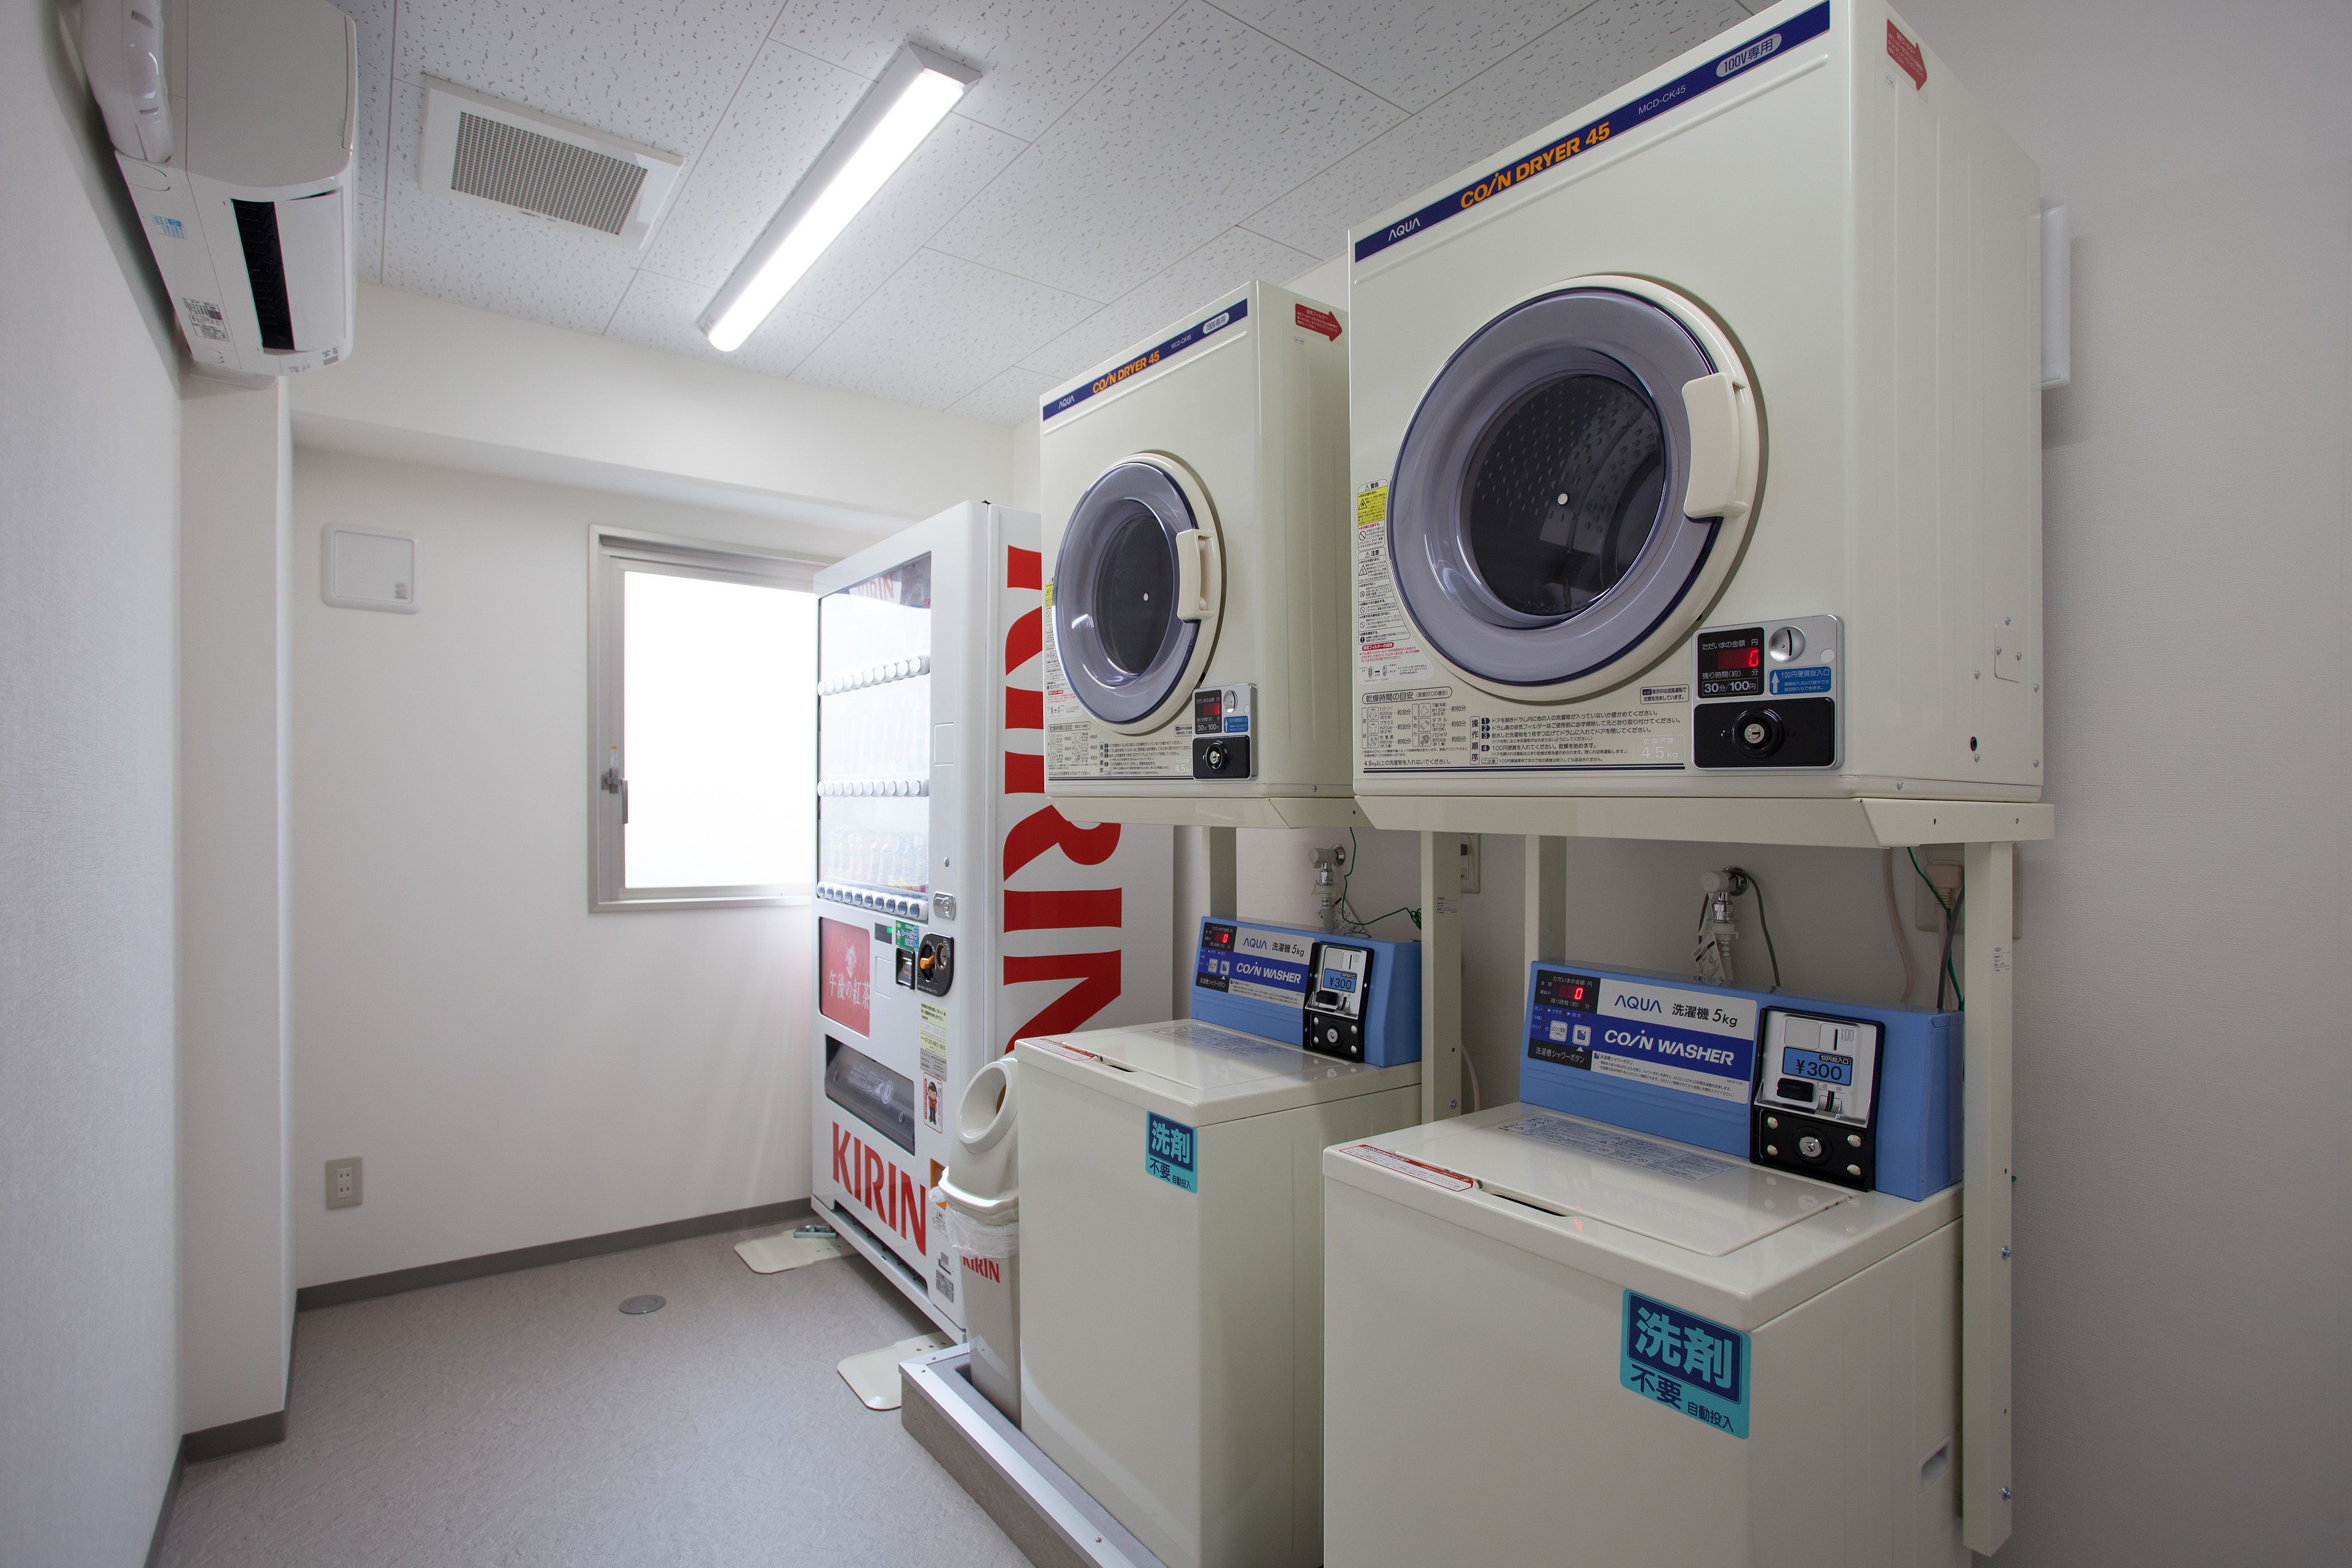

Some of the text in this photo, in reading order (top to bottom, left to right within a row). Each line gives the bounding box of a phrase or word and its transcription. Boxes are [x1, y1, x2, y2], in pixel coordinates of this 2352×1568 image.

[1388, 217, 1421, 242] AQUA
[1515, 138, 1580, 184] DRYER
[1585, 121, 1610, 146] 45
[1638, 85, 1686, 115] MCD-CK45
[1722, 38, 1774, 74] 100V専用
[1058, 394, 1074, 409] AQUA
[1117, 356, 1147, 382] DRYER
[1148, 350, 1159, 364] 45
[1205, 314, 1226, 332] 100V専用
[1702, 639, 1745, 650] ただいまの金額
[1749, 650, 1759, 667] 0
[1781, 669, 1830, 679] 100円硬貨投入口
[1704, 680, 1756, 693] 30分/100円
[1366, 692, 1414, 703] 乾燥時間の目安
[1642, 747, 1678, 760] 4.5 kg
[1222, 933, 1229, 943] 0
[1243, 937, 1305, 957] AQUA 洗濯機 5kg
[1263, 968, 1302, 984] WASHER
[1329, 976, 1352, 990] ¥300
[1553, 976, 1586, 986] ただいまの金額
[829, 970, 870, 1010] 午後の紅茶
[1574, 987, 1584, 1000] 0
[1614, 995, 1738, 1028] AQUA 洗濯機 5kg
[1840, 1028, 1854, 1042] 100
[1536, 1047, 1585, 1063] 洗濯槽シャワーボタン
[1600, 1054, 1634, 1065] 洗濯槽シャワーボタン
[1658, 1042, 1735, 1066] WASHER
[1820, 1054, 1849, 1065] 100円投入口
[1795, 1058, 1843, 1081] ¥300
[1151, 1120, 1191, 1165] 洗剤
[1149, 1157, 1191, 1191] 不要 自動投入
[832, 1121, 926, 1257] KIRIN
[1635, 1306, 1732, 1389] 洗剤
[1630, 1364, 1734, 1433] 不要 自動投入
